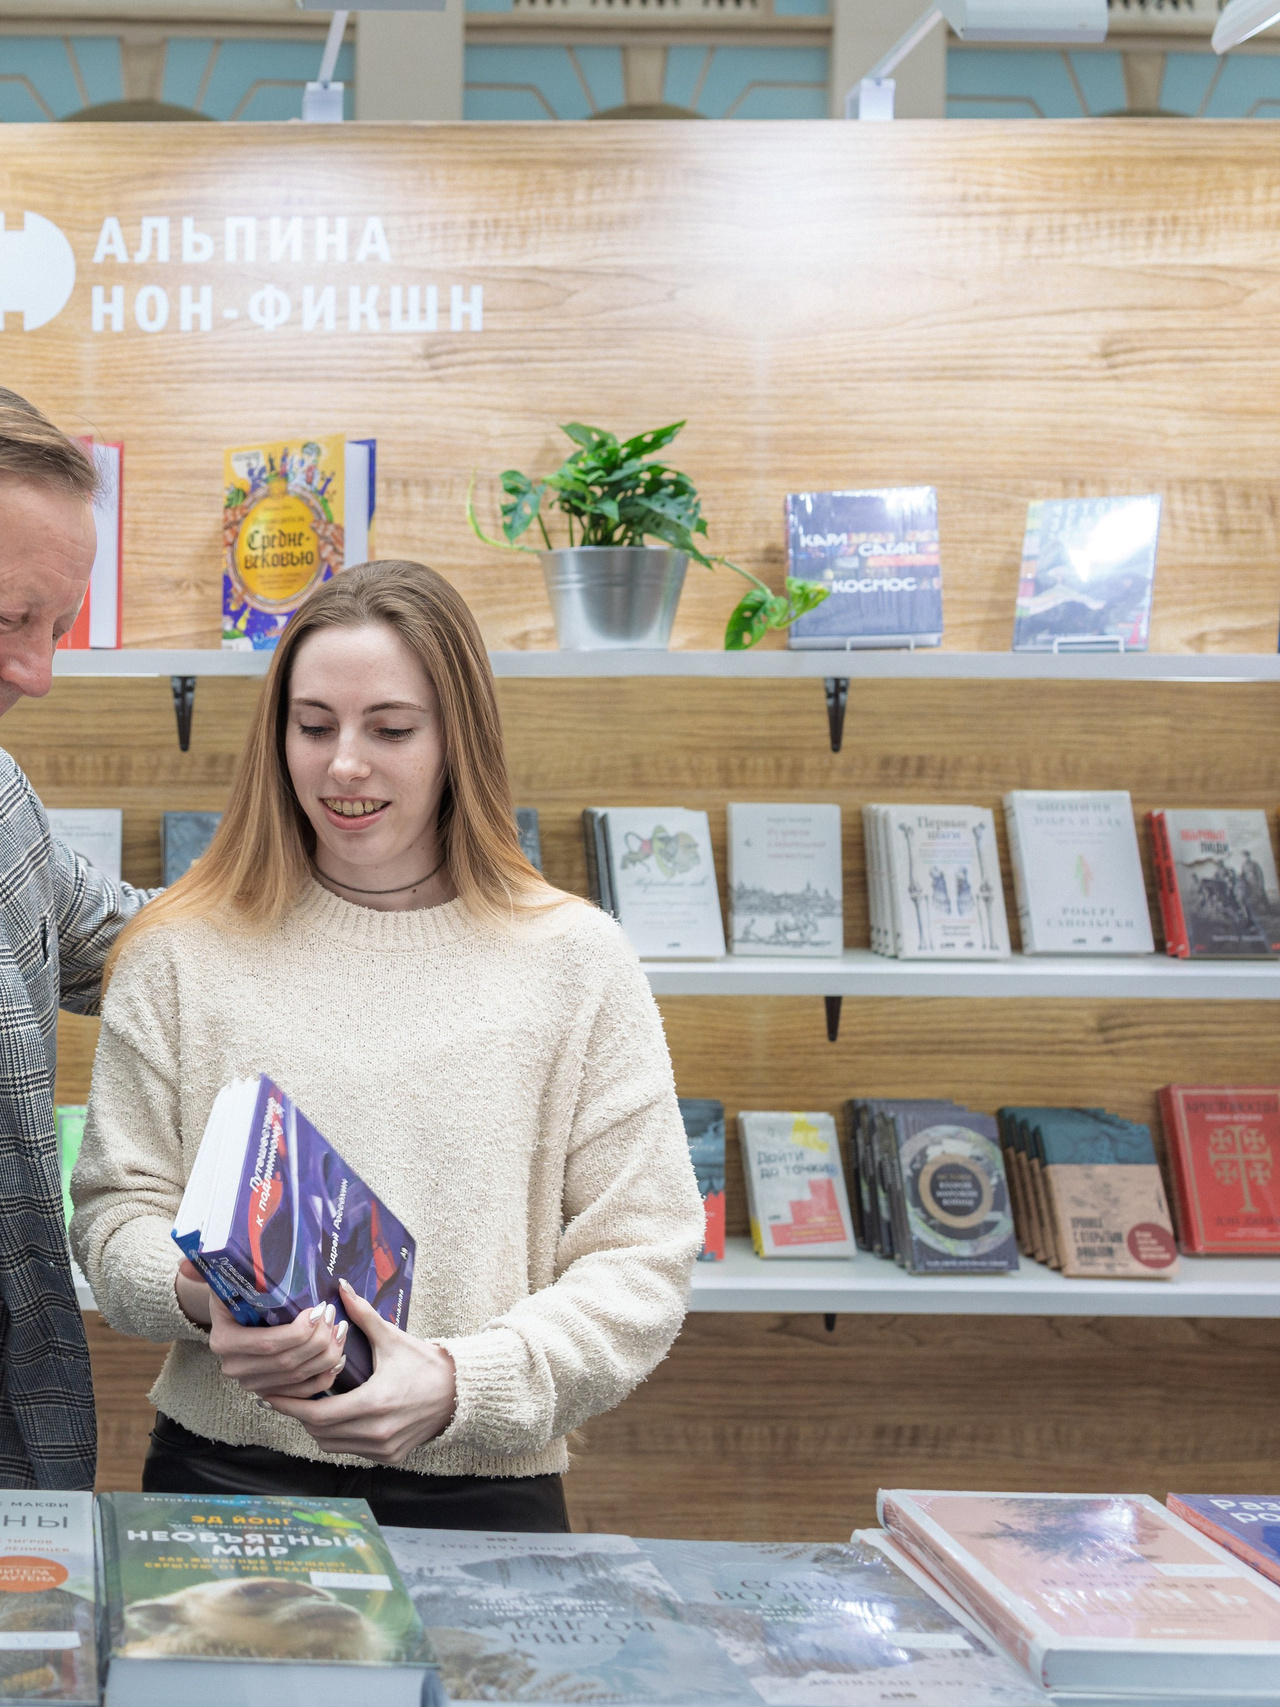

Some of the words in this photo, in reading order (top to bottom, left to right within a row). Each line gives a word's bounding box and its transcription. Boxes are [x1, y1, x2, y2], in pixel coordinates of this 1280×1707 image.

[93, 217, 393, 264] АЛЬПИНА
[91, 283, 484, 333] НОН-ФИКШН
[246, 529, 312, 551] Средне-
[243, 550, 315, 571] вековью
[830, 576, 919, 595] КОСМОС
[249, 1096, 278, 1193] Путешествие
[259, 1120, 284, 1214] подлинному
[327, 1229, 339, 1276] Андрей
[219, 1257, 261, 1297] Путешествие
[191, 1515, 224, 1525] ЭД
[232, 1514, 292, 1526] ЙОНГ
[127, 1530, 367, 1548] НЕОБЪЯТНЫЙ
[4, 1545, 71, 1553] ЛЕНИВЦЕВ
[211, 1544, 289, 1557] МИР
[713, 1588, 763, 1602] ВО
[461, 1618, 586, 1633] ЛЬДАХ
[605, 1620, 656, 1633] ВО
[510, 1632, 628, 1646] СОВЫ
